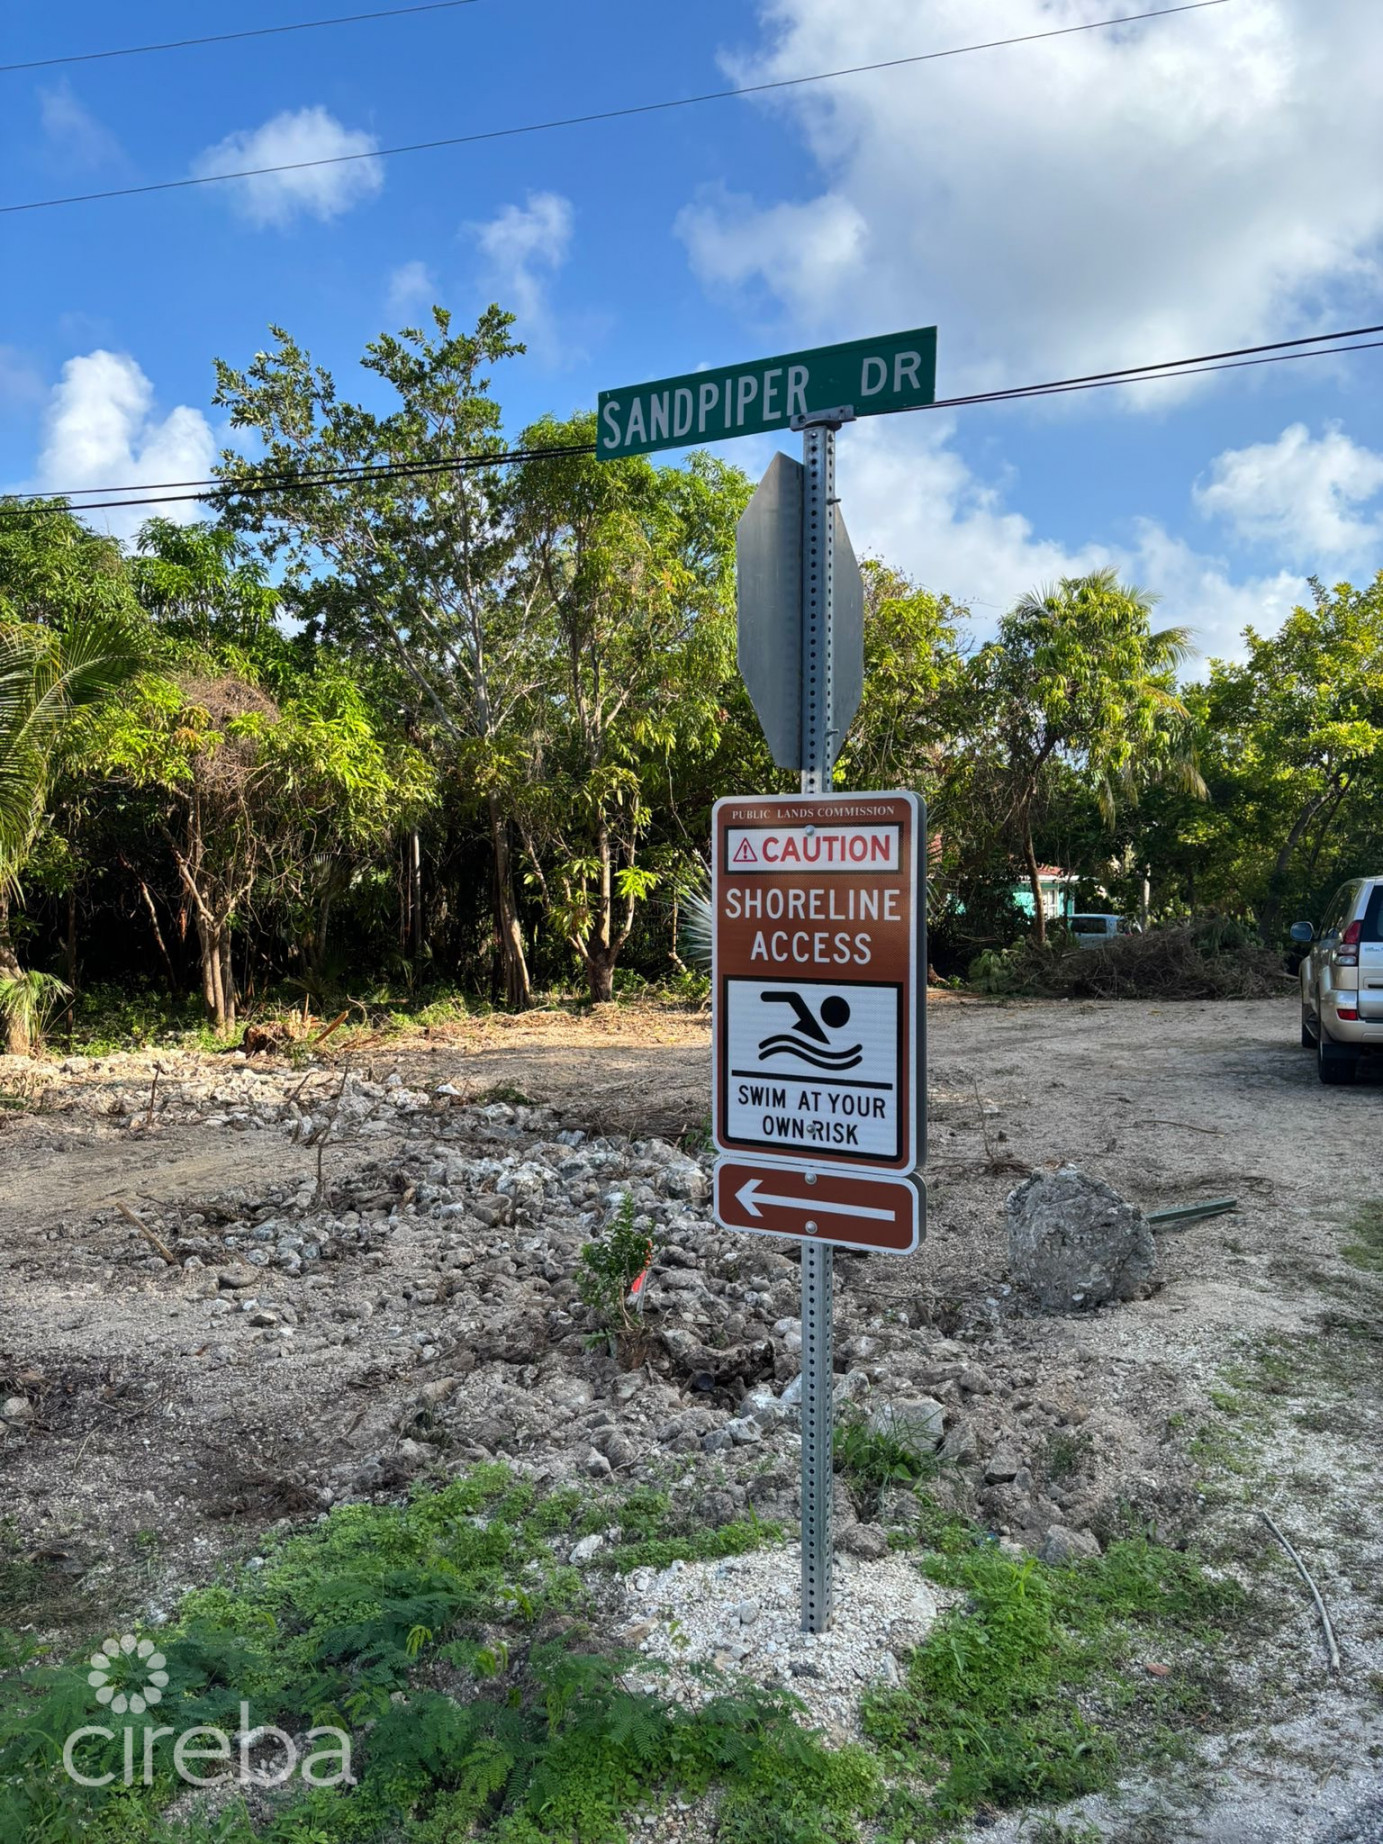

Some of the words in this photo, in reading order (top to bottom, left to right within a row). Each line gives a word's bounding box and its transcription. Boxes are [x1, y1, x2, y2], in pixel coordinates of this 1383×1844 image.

[603, 365, 810, 449] SANDPIPER
[861, 351, 922, 397] DR
[732, 810, 771, 820] PUBLIC
[777, 808, 814, 818] LANDS
[817, 806, 895, 817] COMMISSION
[762, 835, 890, 863] CAUTION
[725, 888, 901, 921] SHORELINE
[751, 931, 872, 965] ACCESS
[738, 1085, 786, 1109] SWIM
[798, 1092, 822, 1113] AT
[828, 1094, 886, 1119] YOUR
[762, 1115, 804, 1139] OWN
[812, 1120, 858, 1145] RISK
